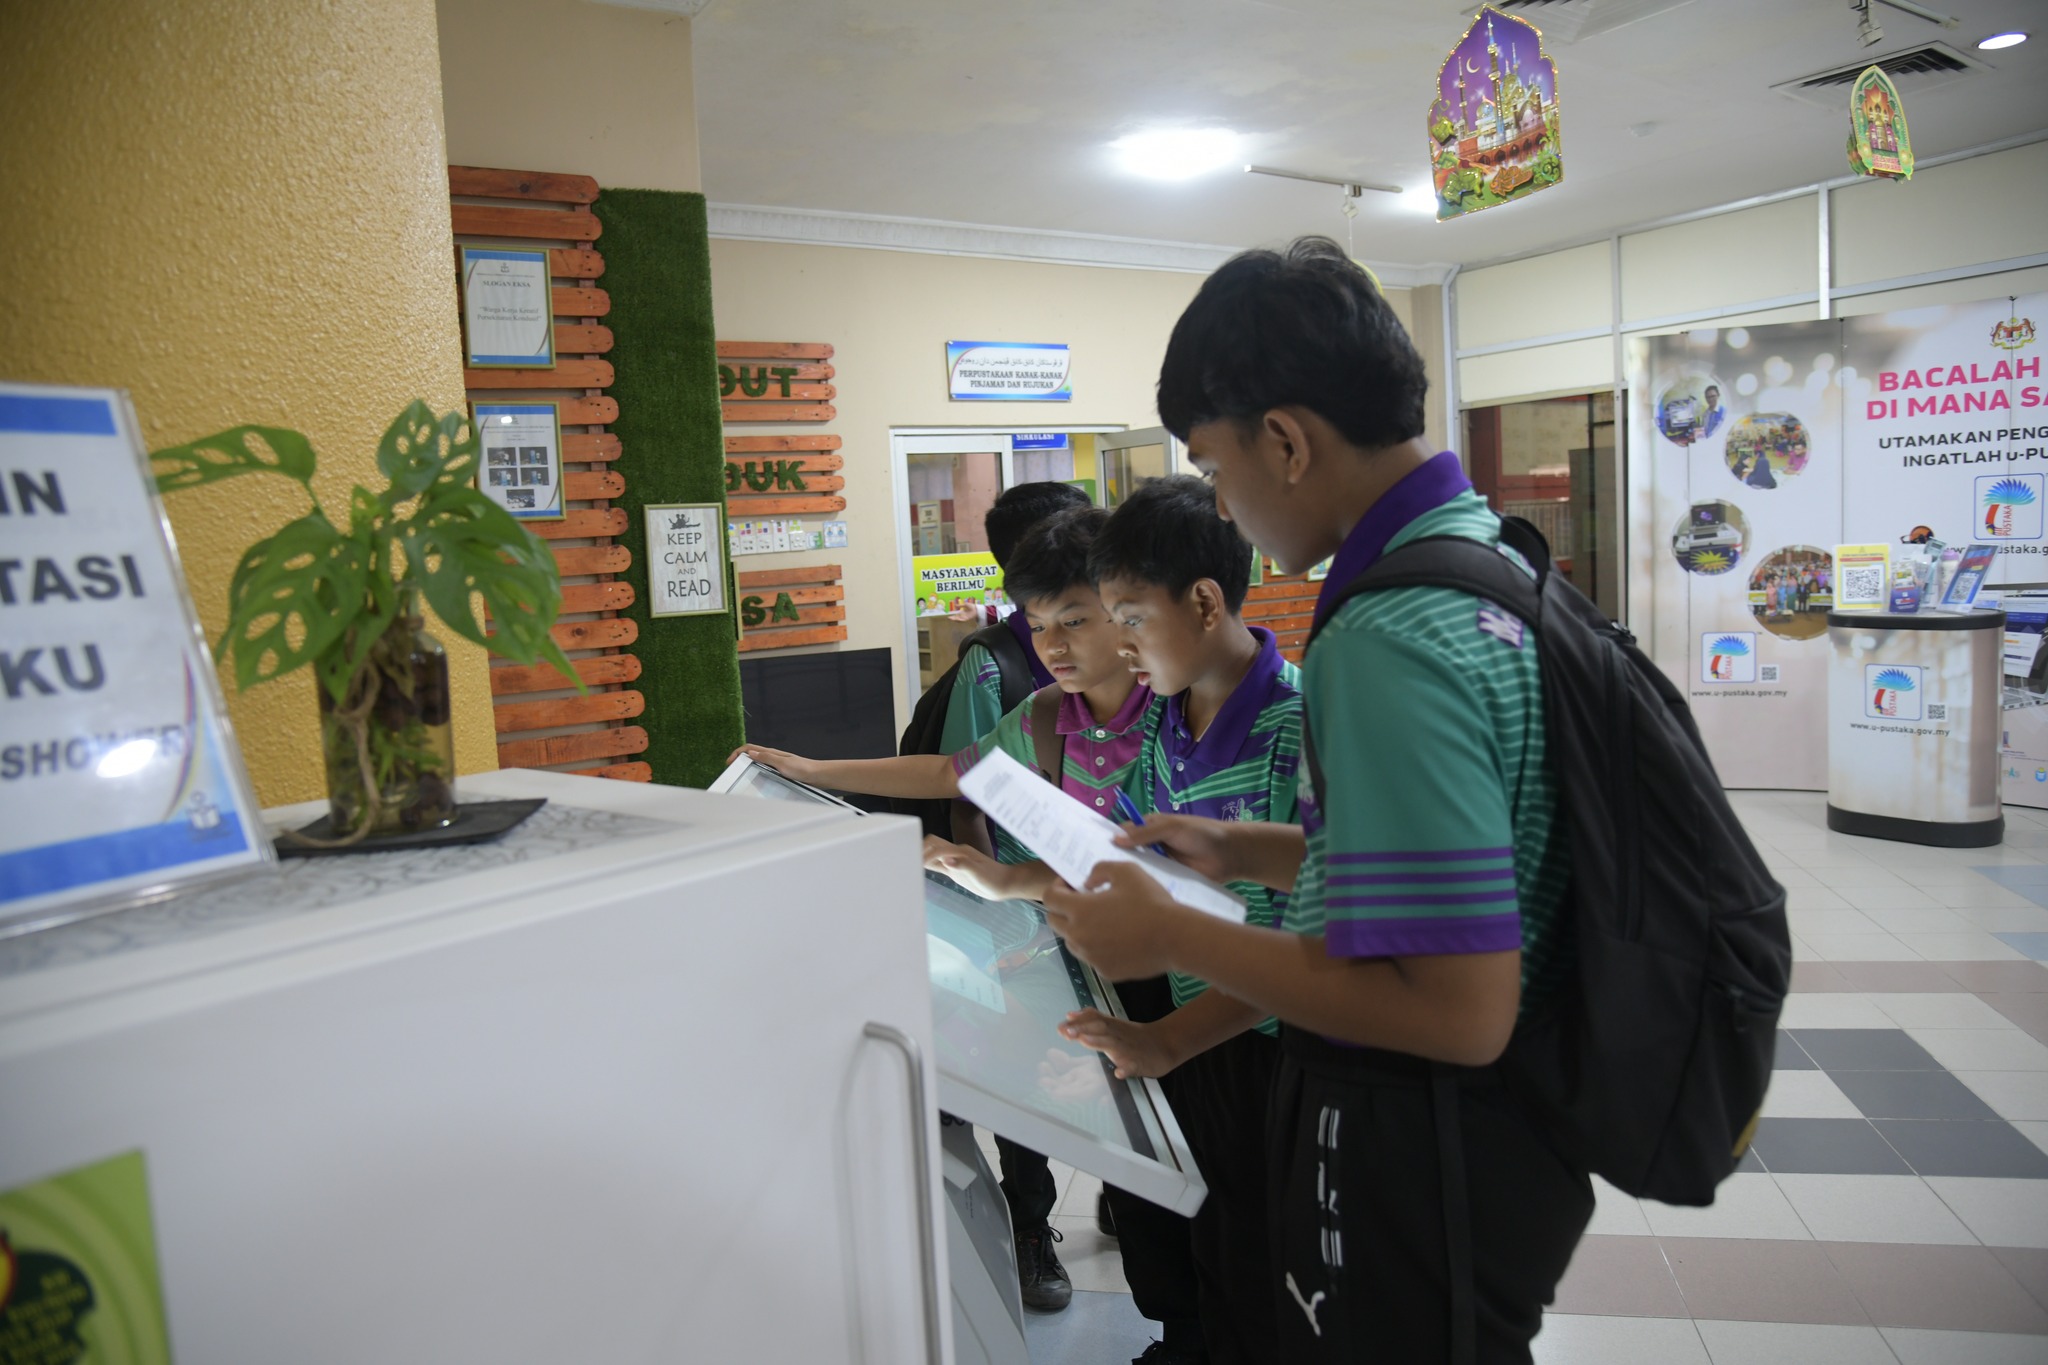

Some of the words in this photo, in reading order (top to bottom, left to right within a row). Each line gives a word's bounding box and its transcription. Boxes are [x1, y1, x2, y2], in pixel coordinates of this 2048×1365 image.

[959, 369, 1013, 379] PERPUSTAKAAN
[1015, 371, 1063, 380] KANAK-KANAK
[1879, 356, 2040, 392] BACALAH
[970, 380, 1005, 388] PINJAMAN
[1007, 380, 1021, 388] DAN
[1023, 381, 1054, 389] RUJUKAN
[1866, 398, 1898, 420] DI
[1907, 388, 2011, 417] MANA
[1879, 430, 1992, 449] UTAMAKAN
[1903, 450, 2001, 467] INGATLAH
[667, 532, 702, 545] KEEP
[663, 550, 708, 565] CALM
[677, 567, 697, 575] AND
[922, 565, 997, 581] MASYARAKAT
[667, 578, 711, 598] READ
[936, 579, 985, 592] BERILMU
[1691, 689, 1788, 698] www.u-pustaka.gov.my
[1850, 722, 1950, 737] www.u-pustaka.gov.my
